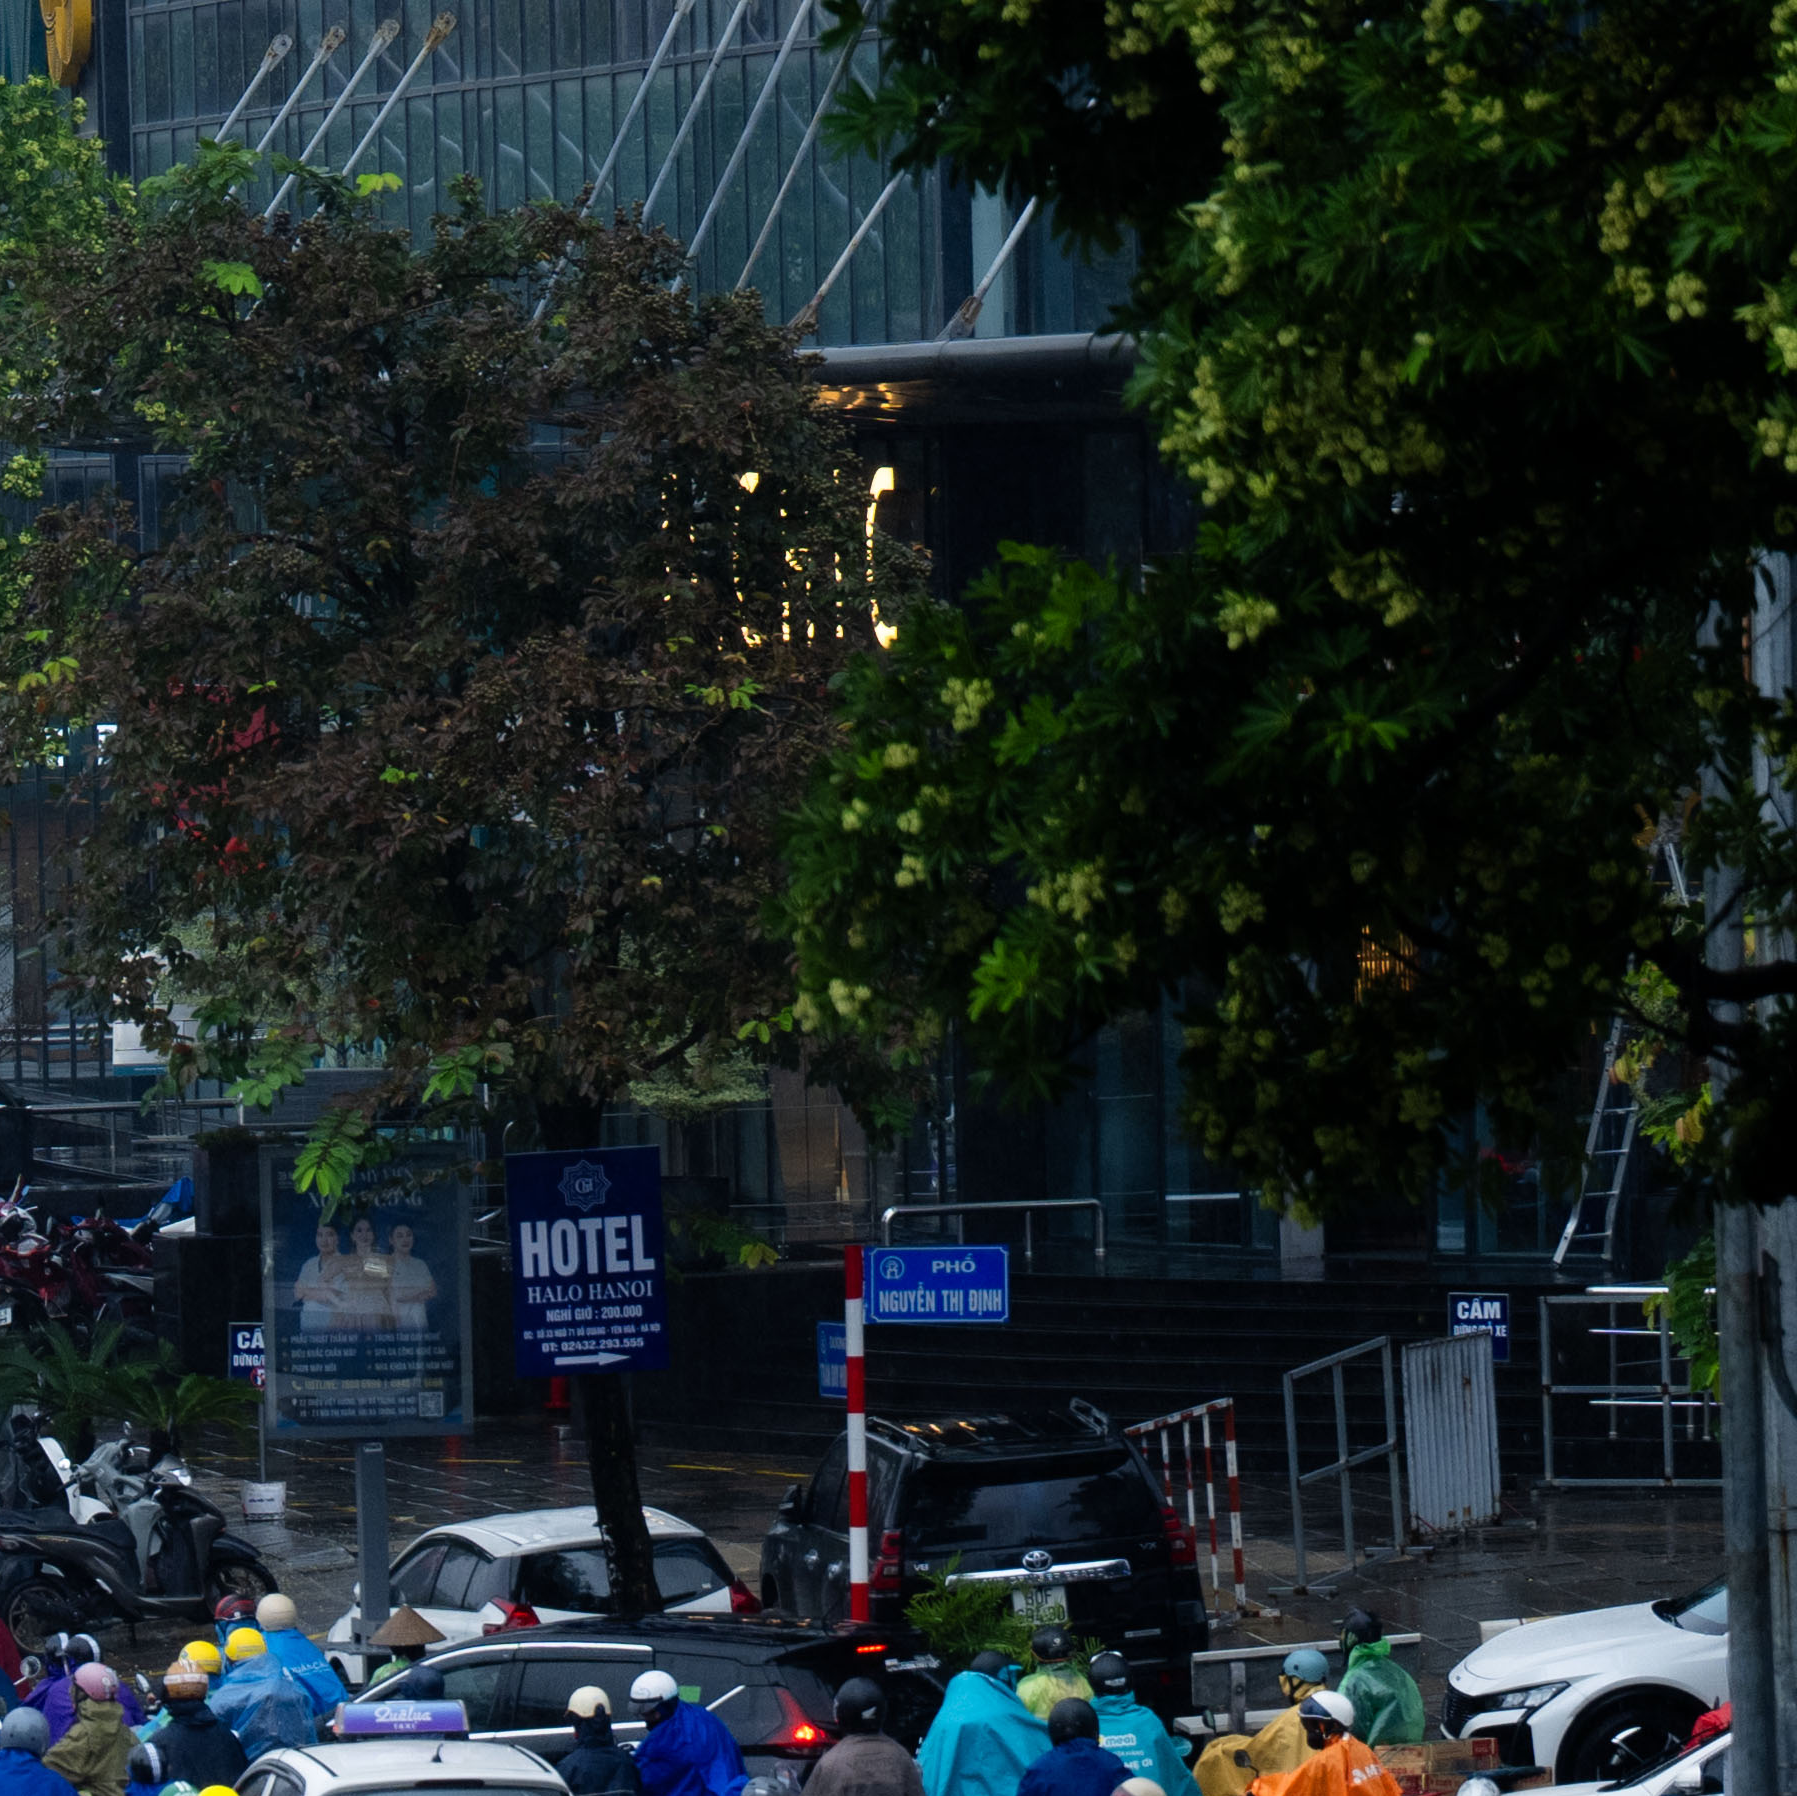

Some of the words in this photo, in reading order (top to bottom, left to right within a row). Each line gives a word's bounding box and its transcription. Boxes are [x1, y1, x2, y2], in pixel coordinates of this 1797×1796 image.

[520, 1215, 656, 1279] HOTEL
[932, 1253, 976, 1274] PHỐ
[527, 1284, 583, 1304] HALO
[589, 1280, 653, 1300] HANOI
[879, 1281, 936, 1312] NGUYỄN
[942, 1289, 964, 1316] THỊ
[969, 1289, 1002, 1316] ĐỊNH
[546, 1304, 572, 1322] NGHỈ
[600, 1305, 643, 1319] 200.000
[1457, 1296, 1501, 1320] CẤM
[1495, 1325, 1508, 1337] XE
